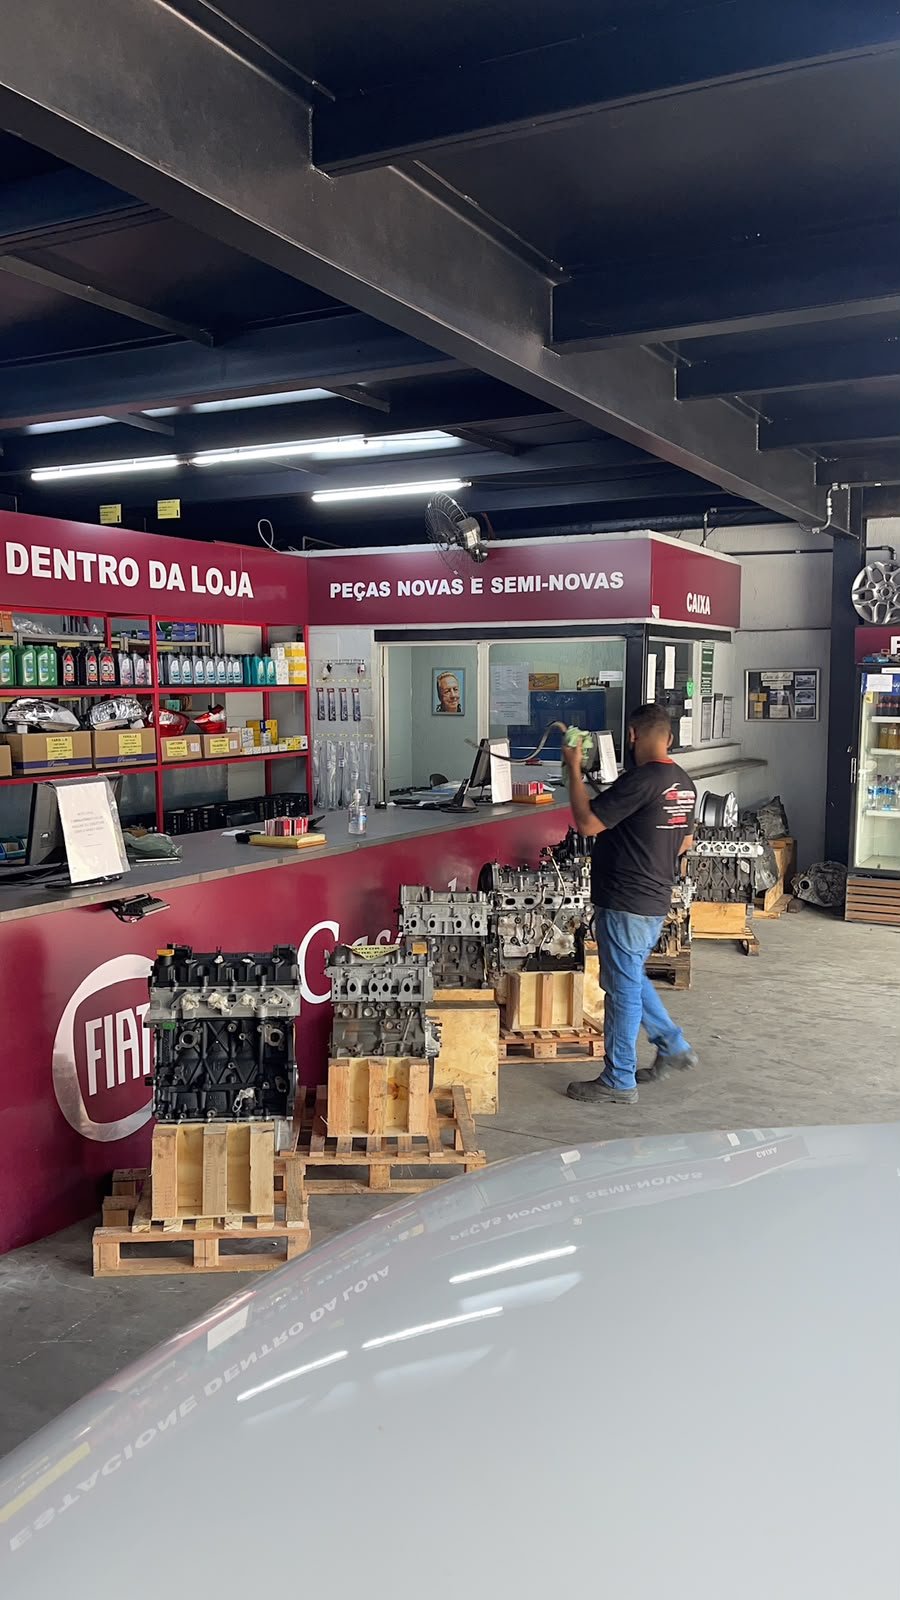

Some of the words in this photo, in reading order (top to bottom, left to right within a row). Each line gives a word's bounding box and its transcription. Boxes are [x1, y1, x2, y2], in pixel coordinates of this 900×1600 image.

[6, 542, 140, 587] DENTRO
[149, 560, 186, 592] DA
[191, 565, 254, 598] LOJA
[330, 581, 391, 601] PEÇAS
[397, 578, 464, 596] NOVAS
[471, 577, 484, 595] E
[490, 571, 624, 594] SEMI-NOVAS
[686, 592, 711, 616] CAIXA
[85, 1002, 151, 1097] FIAT
